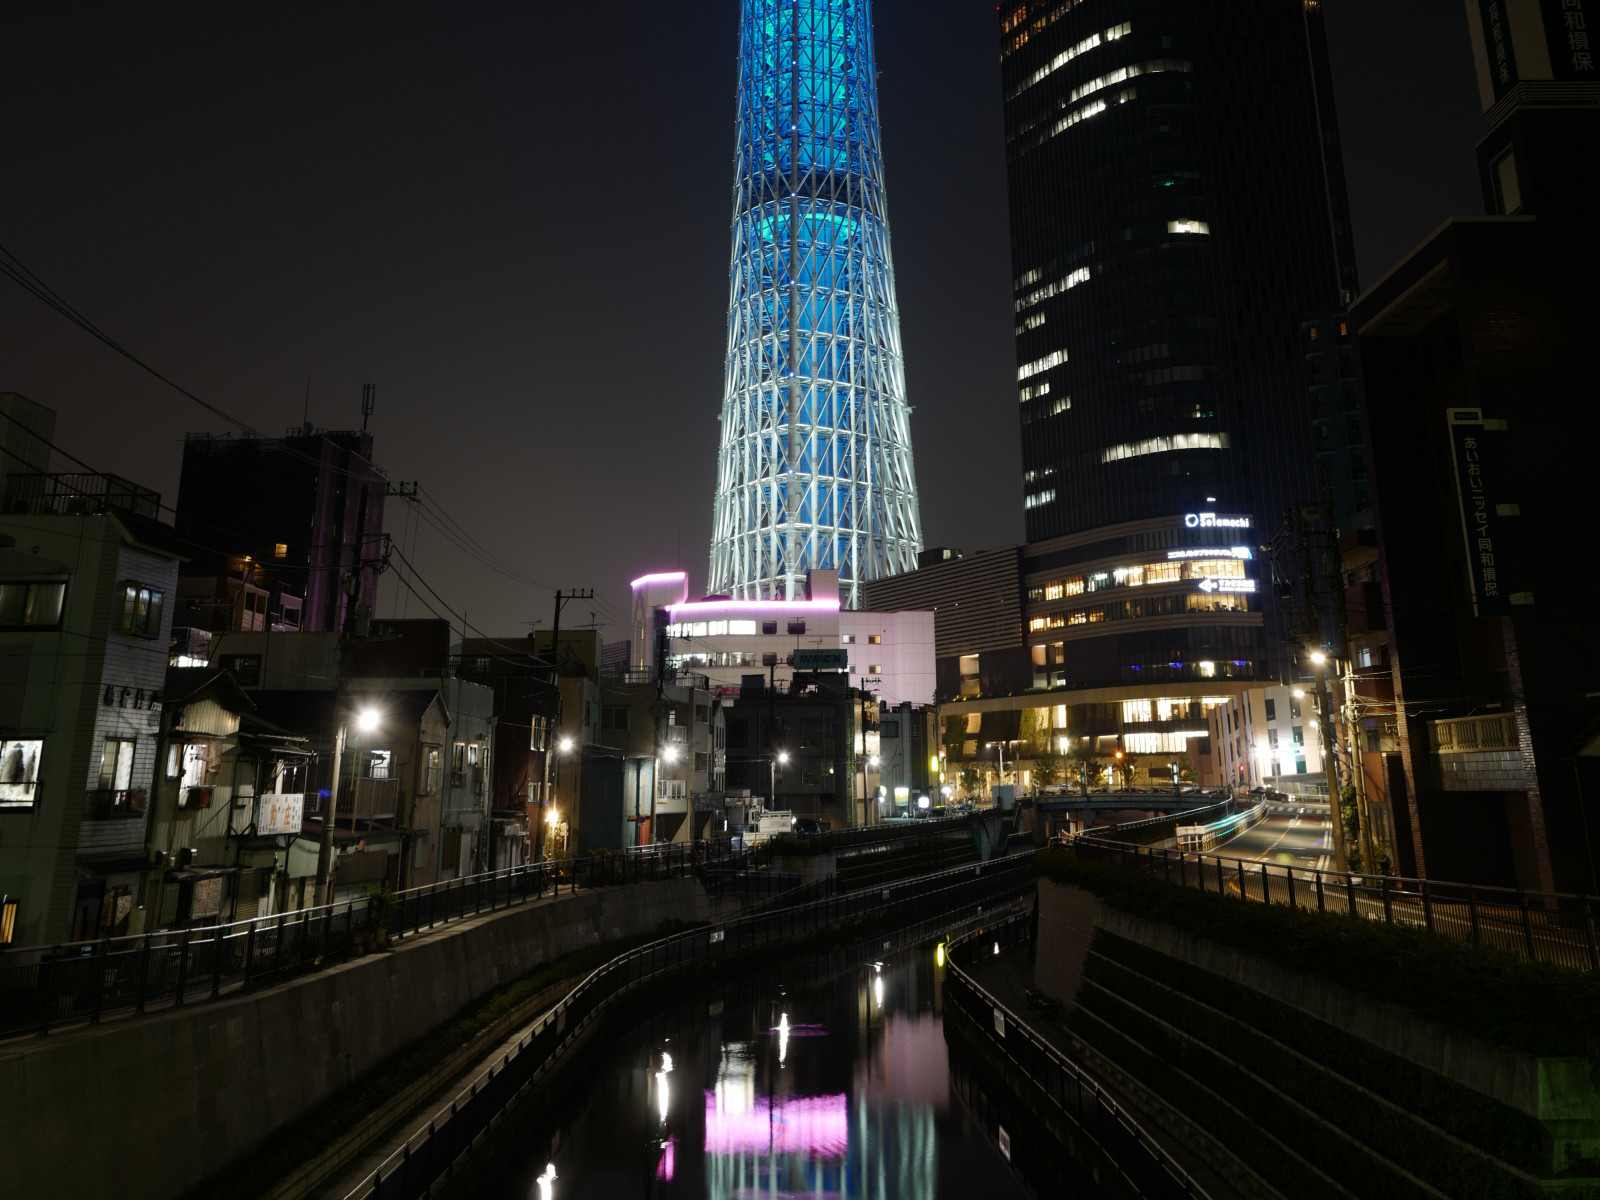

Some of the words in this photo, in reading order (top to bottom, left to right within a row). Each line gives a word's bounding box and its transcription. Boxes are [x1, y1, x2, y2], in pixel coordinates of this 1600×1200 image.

[1464, 436, 1499, 597] あいおいニッセイ同和損保
